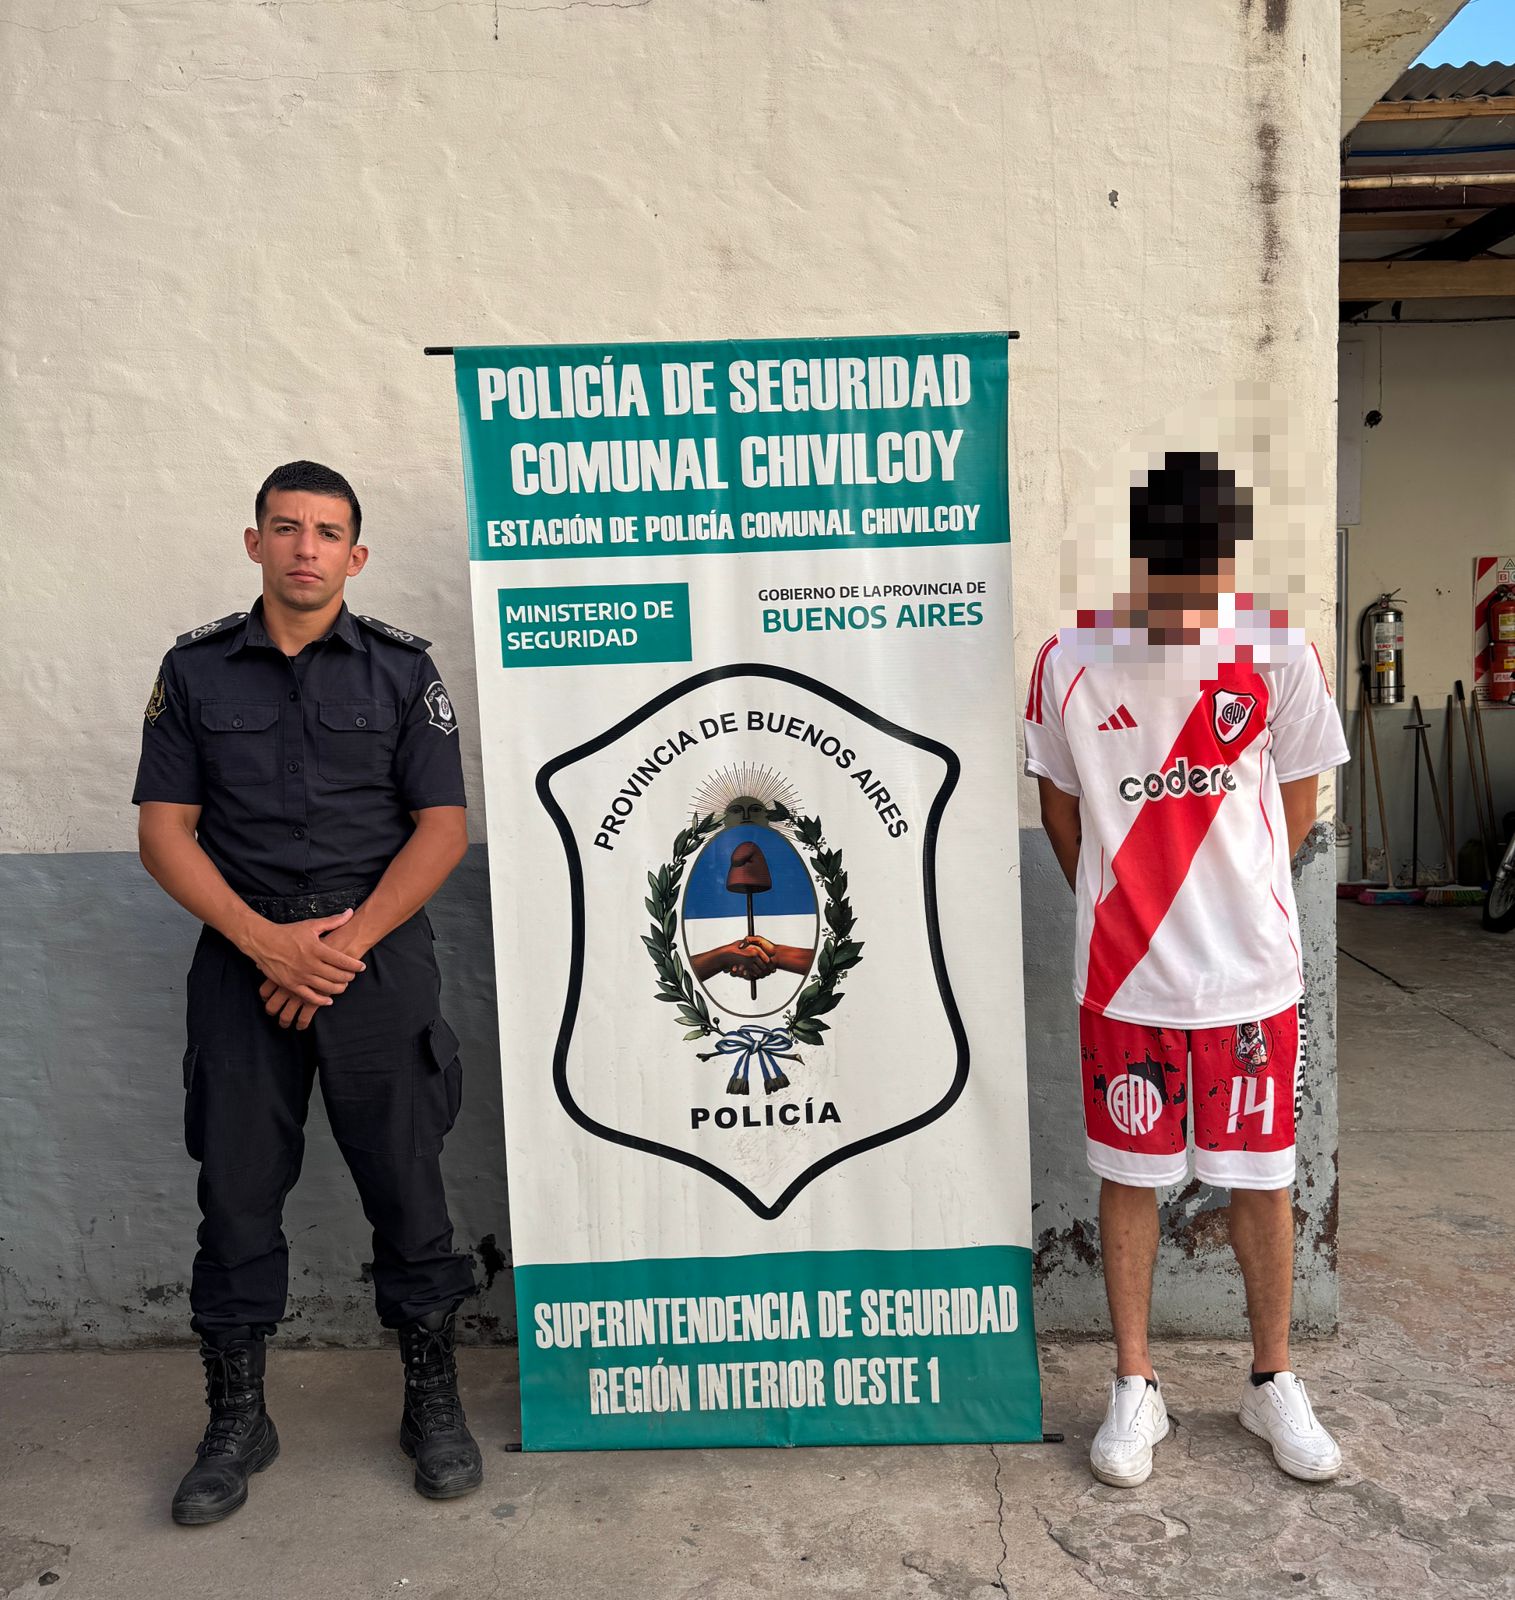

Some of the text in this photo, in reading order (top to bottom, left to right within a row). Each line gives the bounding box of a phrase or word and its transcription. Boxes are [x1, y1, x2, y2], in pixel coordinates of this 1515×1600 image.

[477, 353, 971, 421] POLICÍA DE SEGURIDAD
[510, 429, 964, 496] COMUNAL CHIVILCOY
[487, 504, 981, 547] ESTACIÓN DE POLICÍA COMUNAL CHIVILCOY
[506, 601, 674, 624] MINISTERIO DE
[758, 581, 987, 602] GOBIERNO DE LA PROVINCIA DE
[507, 628, 638, 651] SEGURIDAD
[762, 601, 983, 633] BUENOS AIRES
[593, 710, 910, 851] PROVINCIA DE BUENOS AIRES
[1119, 759, 1237, 802] codere
[691, 1097, 841, 1129] POLICÍA
[1106, 1074, 1163, 1136] CARP
[1226, 1076, 1274, 1134] 14
[534, 1285, 1019, 1349] SUPERINTENDENCIA DE SEGURIDAD
[589, 1357, 940, 1415] REGIÓN INTERIOR OESTE 1
